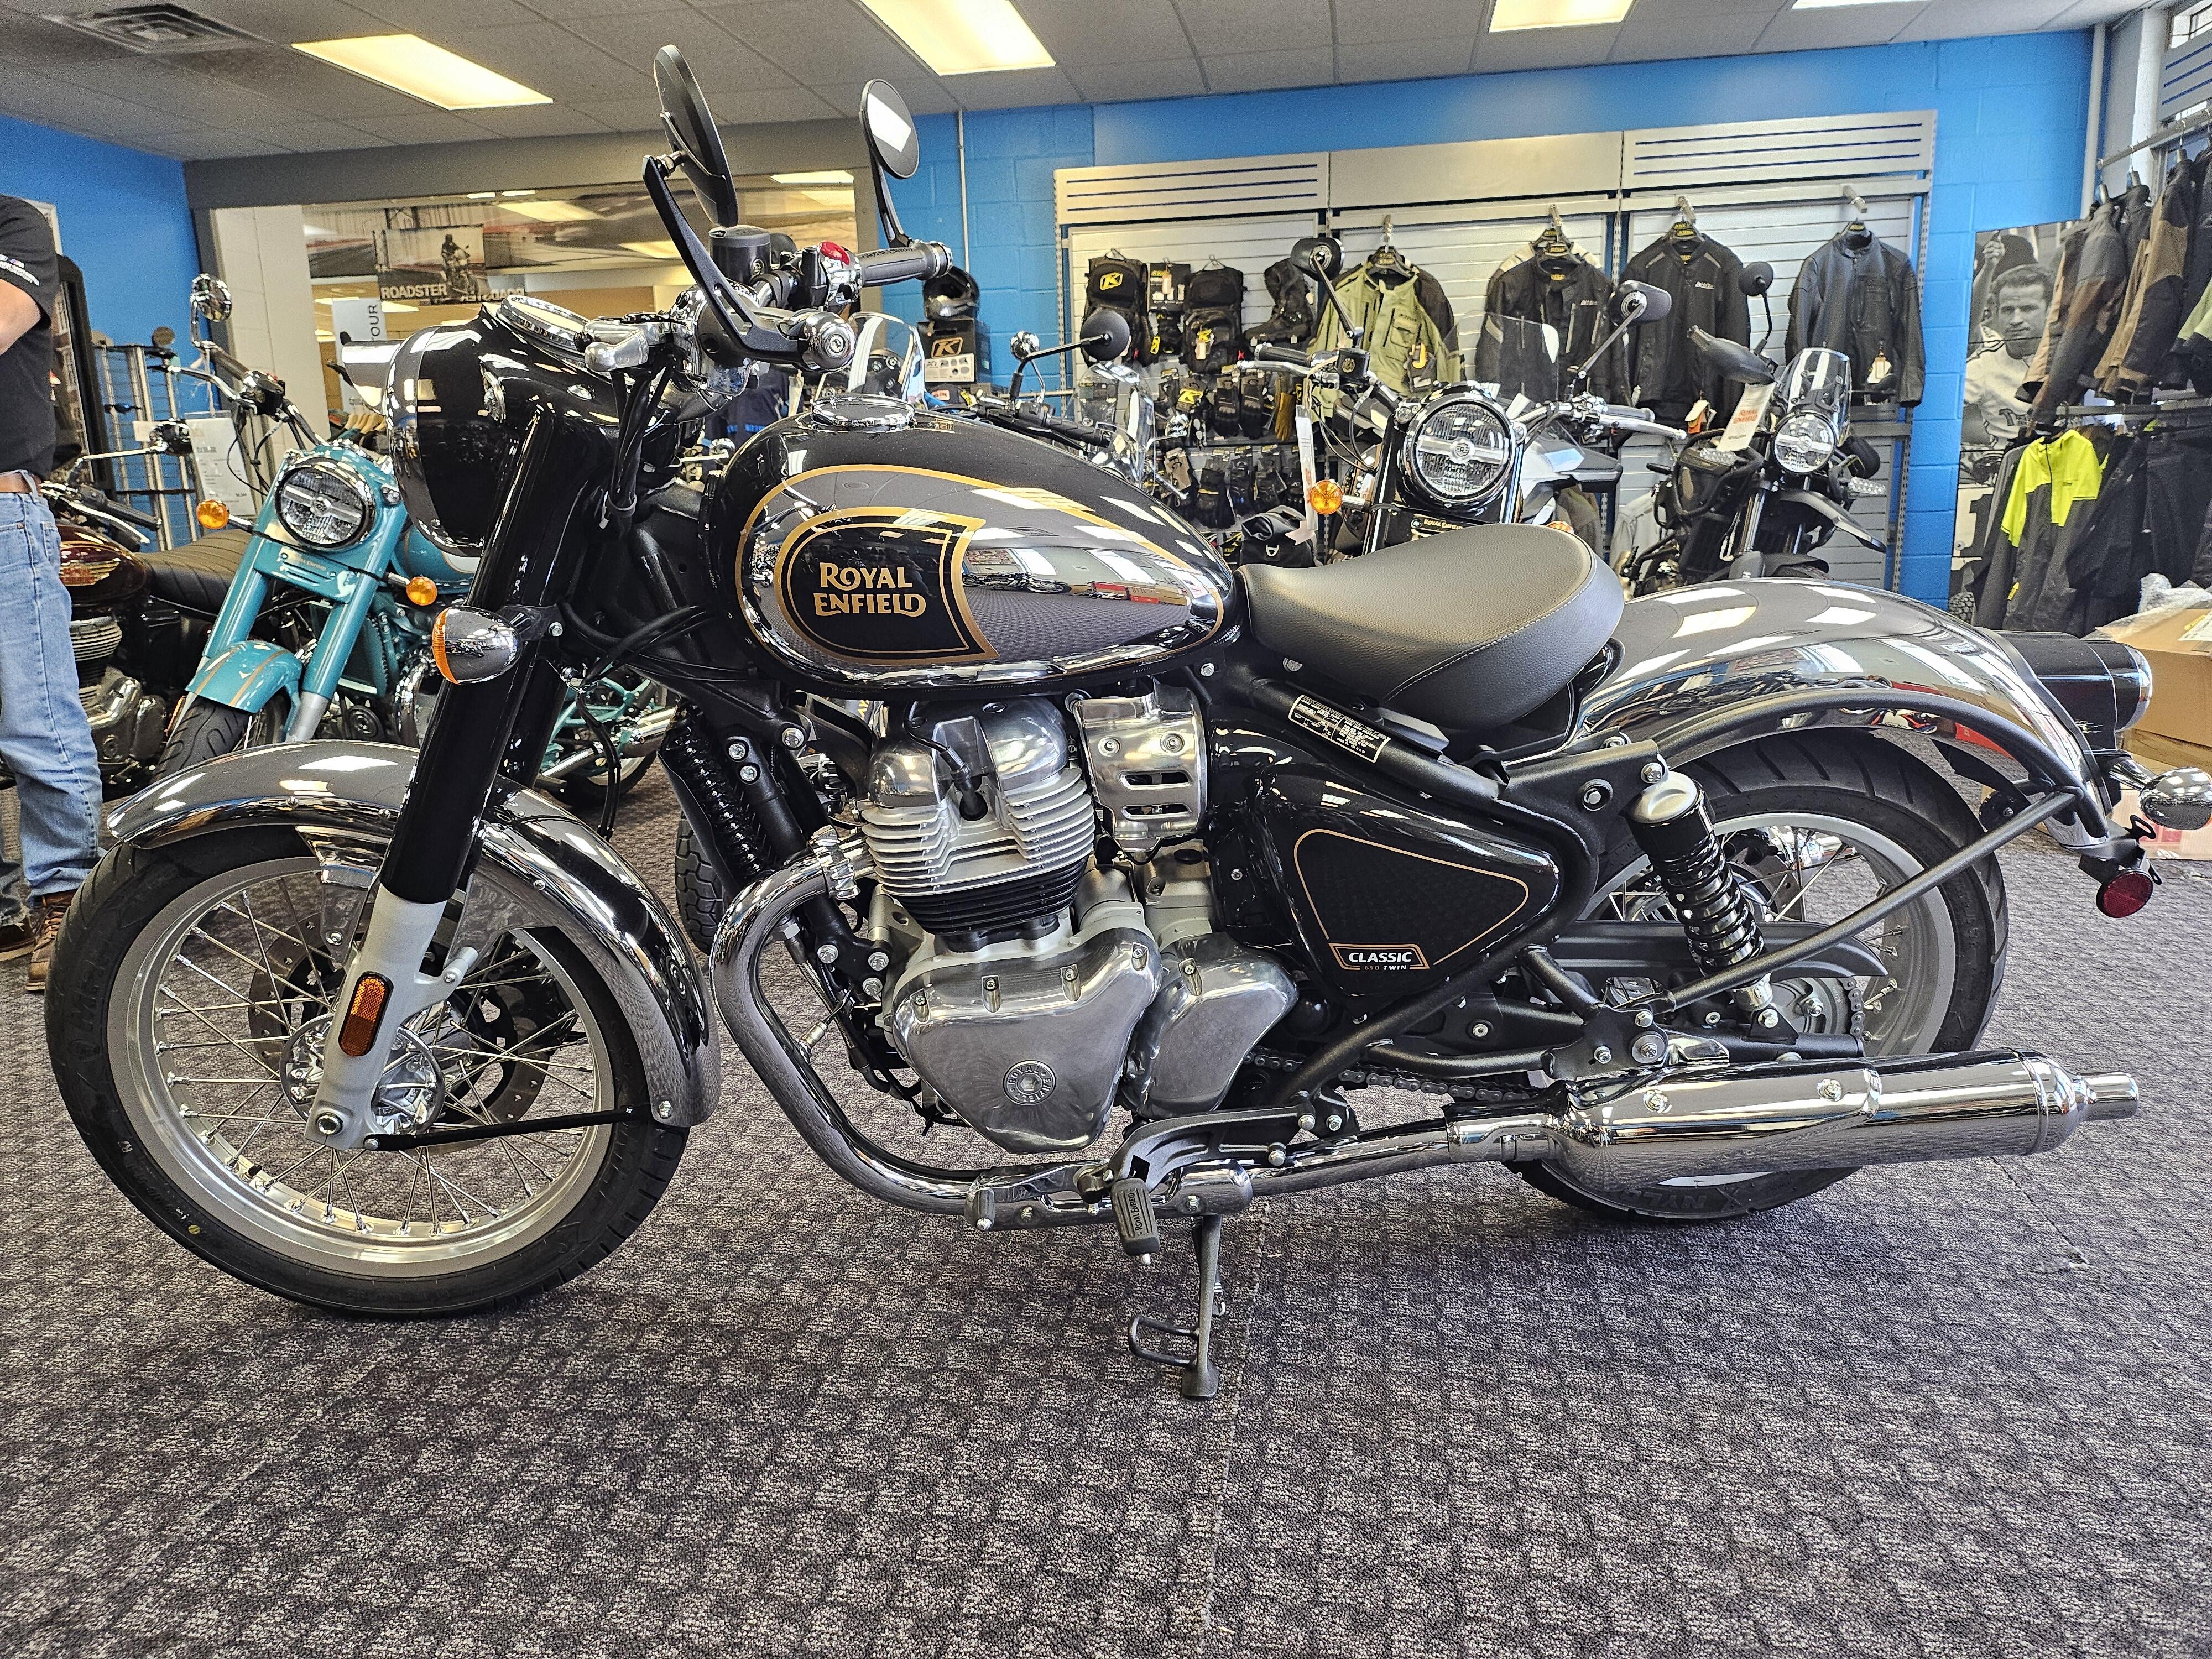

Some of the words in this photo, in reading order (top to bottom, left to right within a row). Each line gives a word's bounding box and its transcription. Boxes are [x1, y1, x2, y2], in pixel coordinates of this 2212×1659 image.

[380, 283, 447, 299] ROADSTER
[369, 305, 381, 341] OUR
[1423, 519, 1441, 527] ROYAL
[820, 562, 912, 591] ROYAL
[813, 592, 926, 617] ENFIELD
[1348, 952, 1412, 963] CLASSIC
[1007, 1065, 1040, 1085] ROYAL
[1128, 1192, 1139, 1213] ENFIELD
[1133, 1213, 1143, 1231] ROYAL
